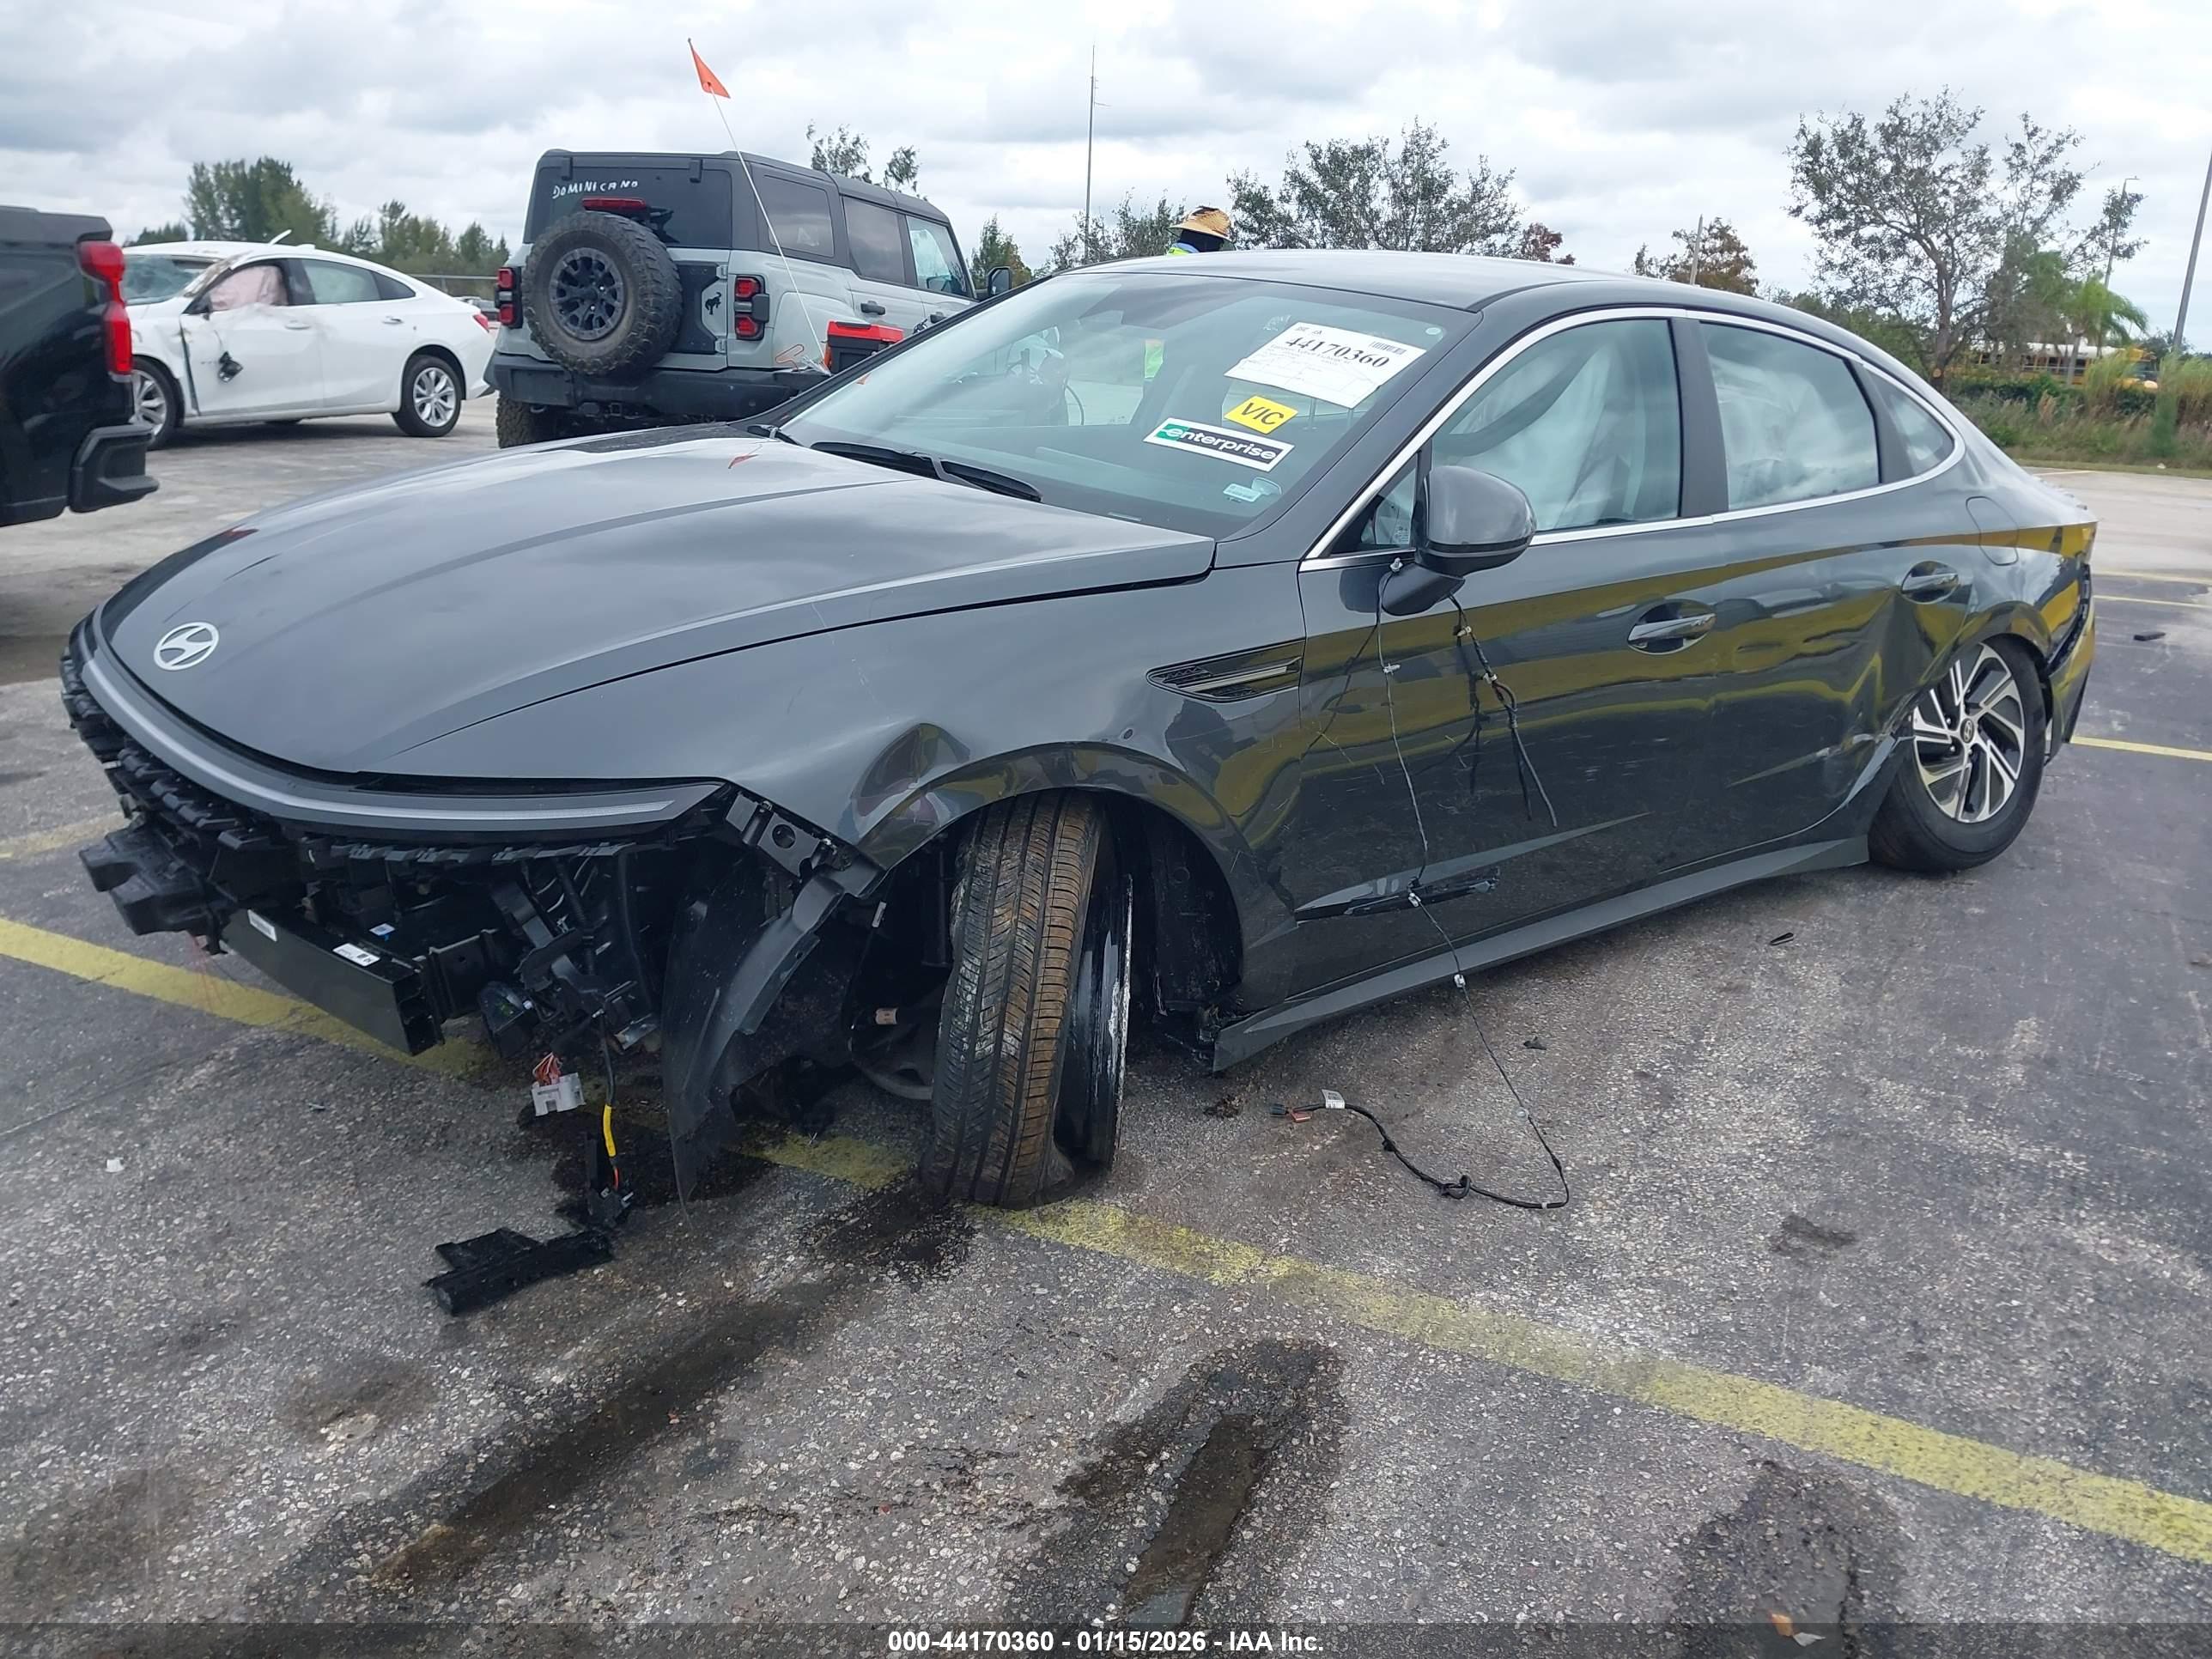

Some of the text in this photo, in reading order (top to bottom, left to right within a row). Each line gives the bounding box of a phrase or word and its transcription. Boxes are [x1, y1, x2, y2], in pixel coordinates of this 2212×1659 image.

[1285, 337, 1389, 368] 44170360
[1242, 402, 1285, 425] VIC
[1163, 428, 1277, 459] enterprise
